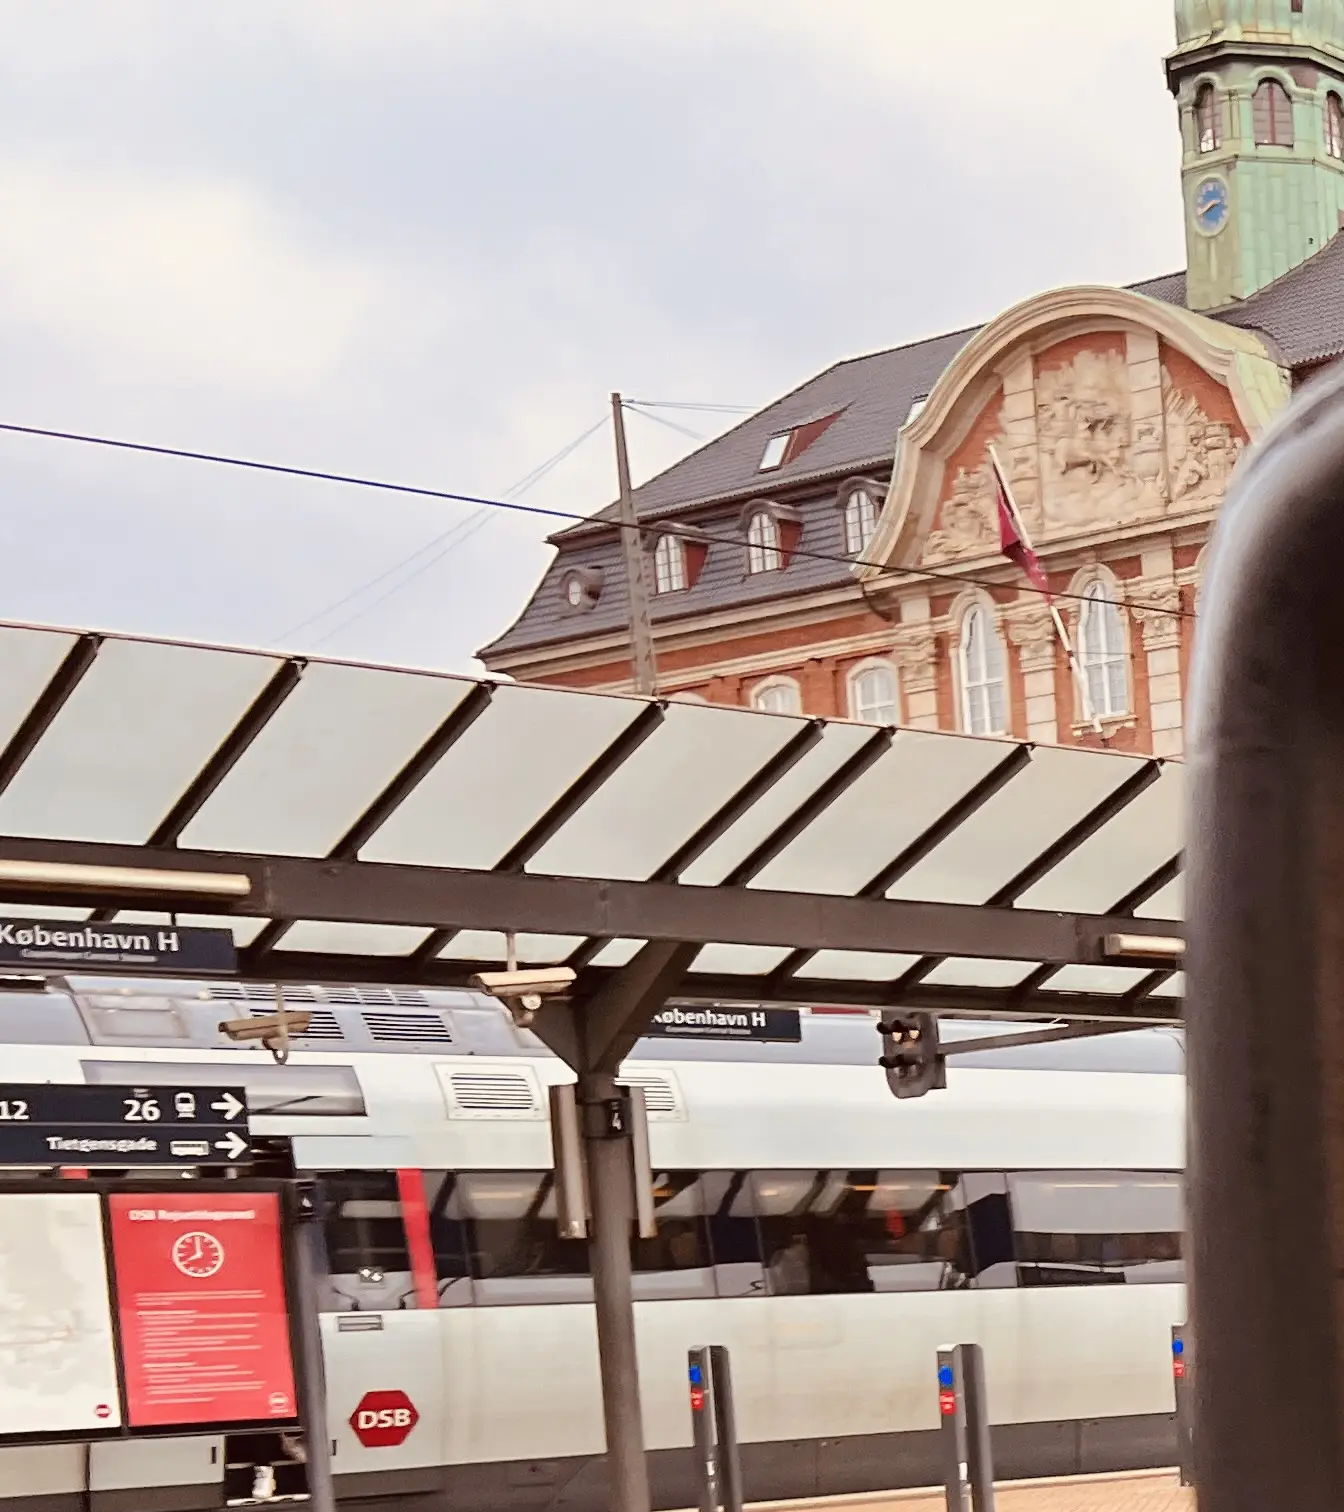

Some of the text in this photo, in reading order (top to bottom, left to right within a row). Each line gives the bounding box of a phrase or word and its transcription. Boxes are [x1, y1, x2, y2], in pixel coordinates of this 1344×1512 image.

[0, 923, 180, 952] København H
[752, 1011, 767, 1028] H
[0, 1099, 162, 1122] 12 26
[358, 1408, 412, 1430] DSB
